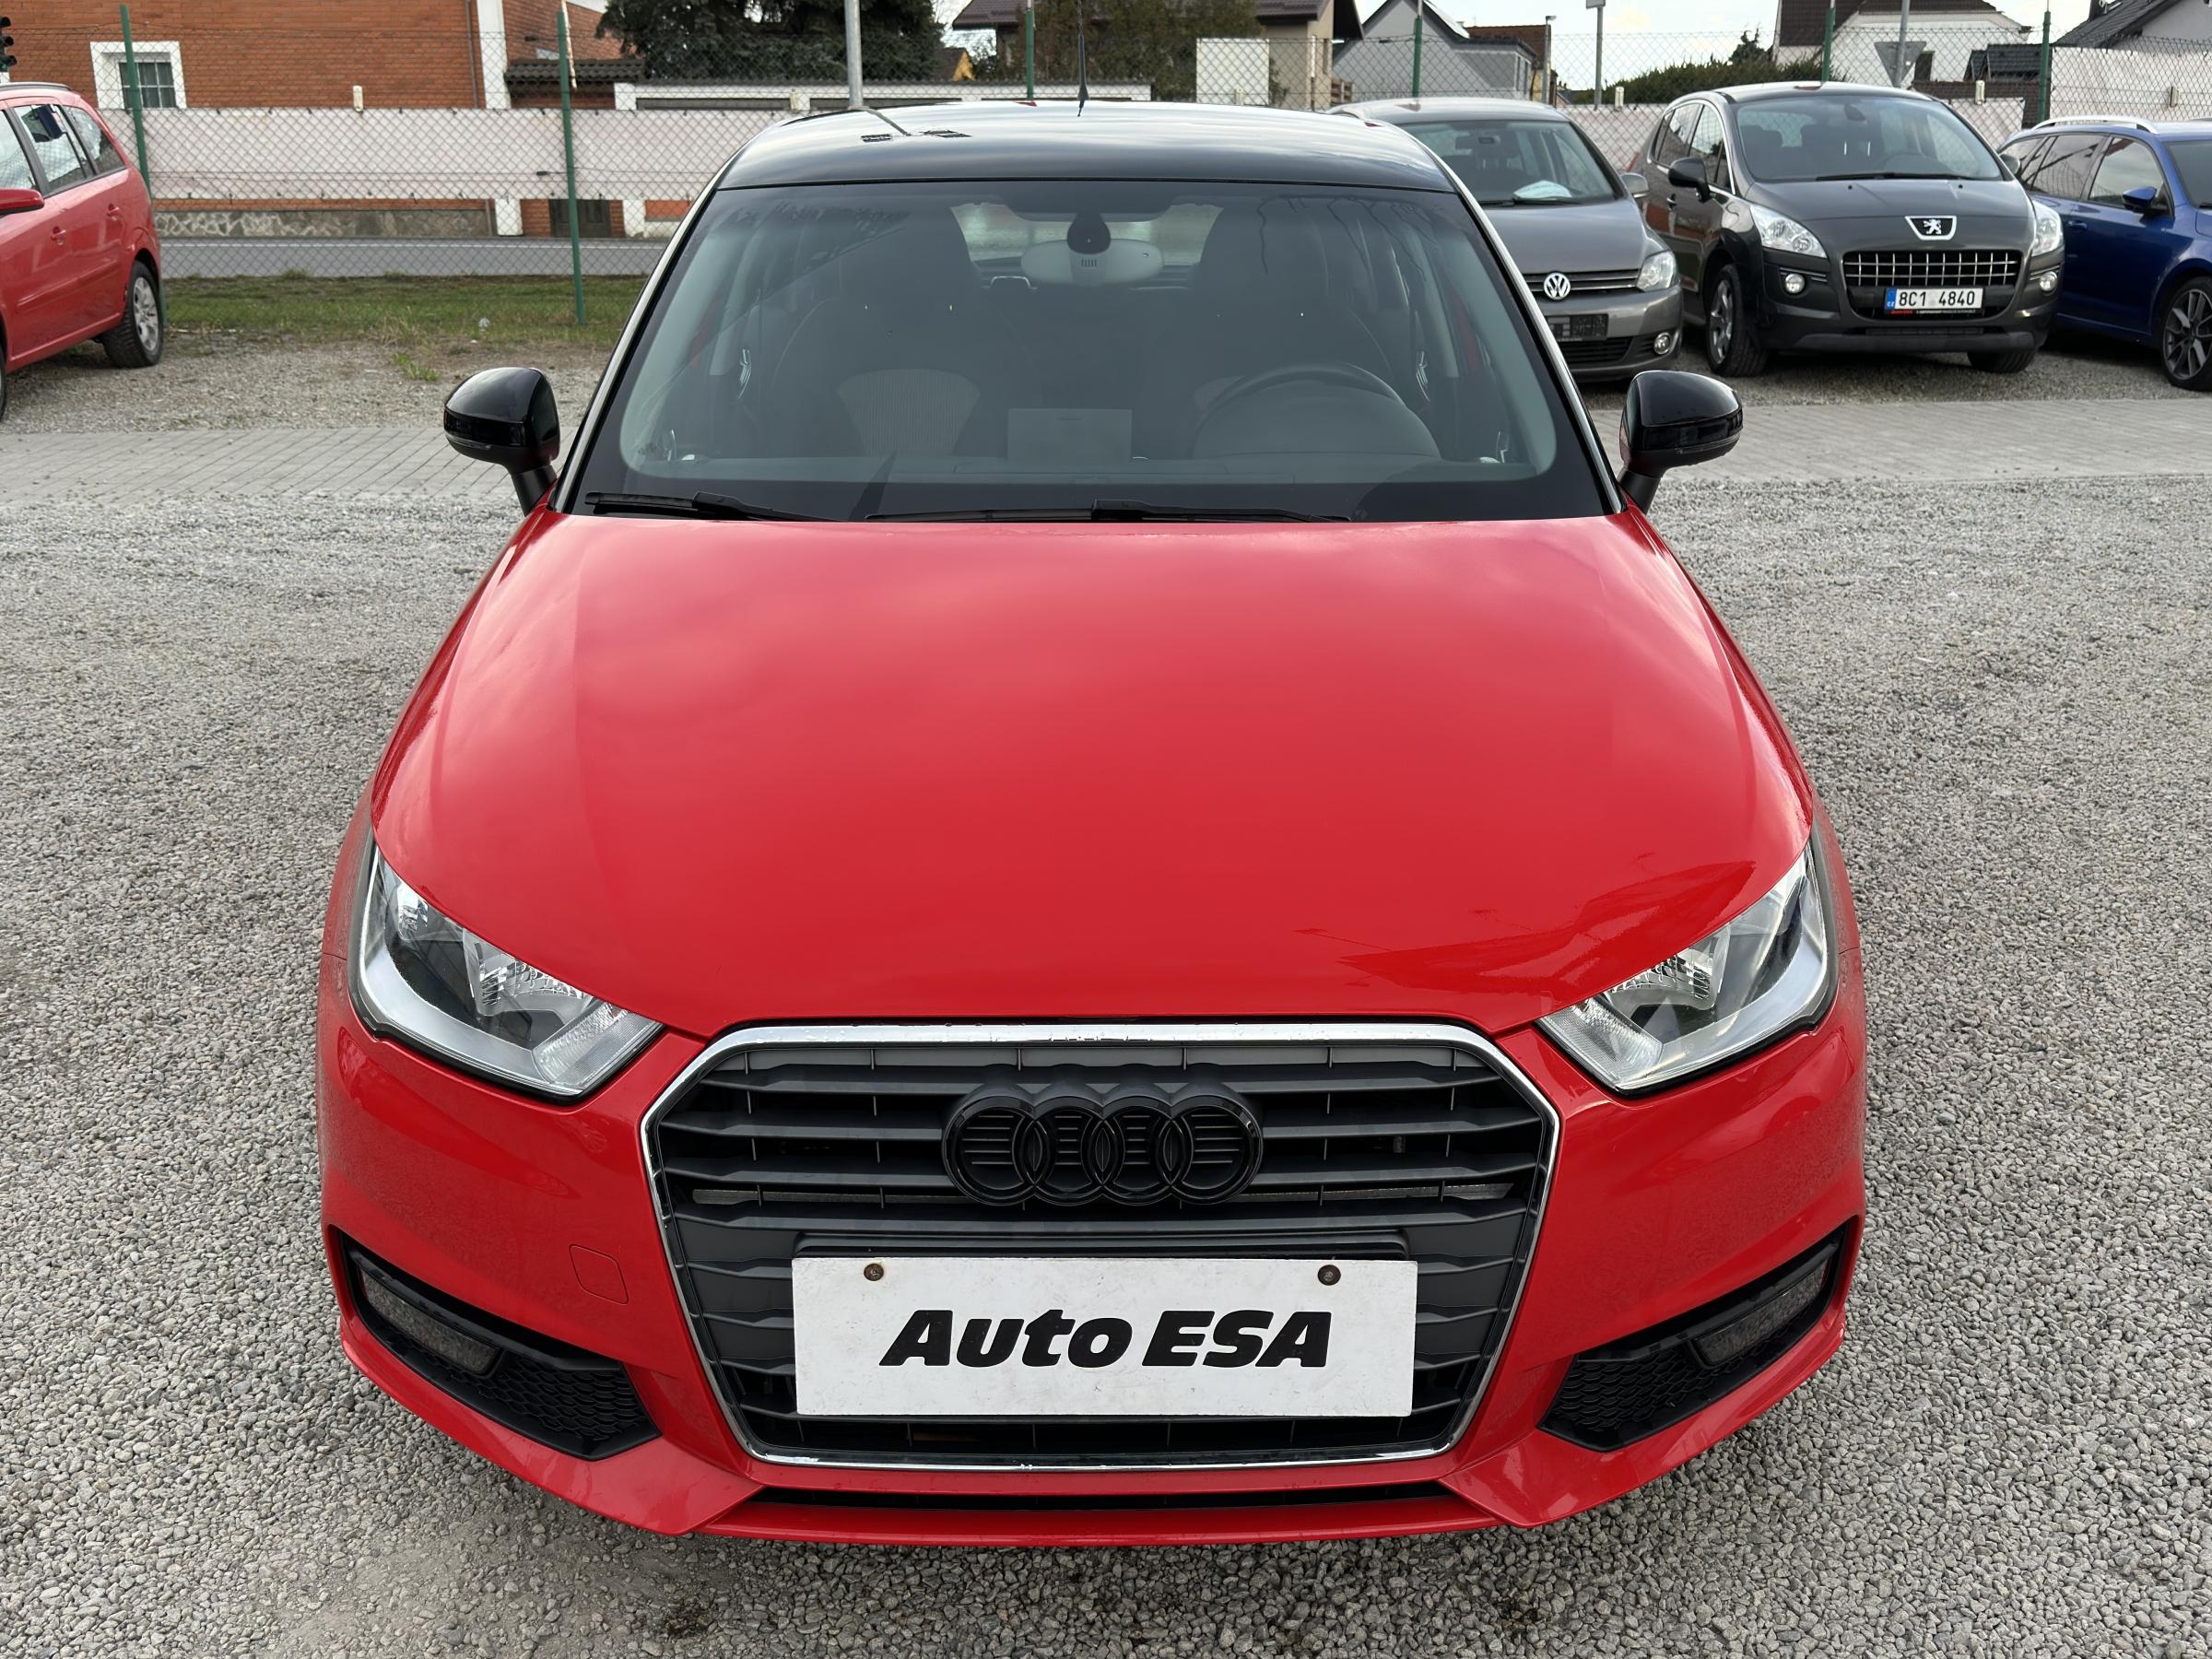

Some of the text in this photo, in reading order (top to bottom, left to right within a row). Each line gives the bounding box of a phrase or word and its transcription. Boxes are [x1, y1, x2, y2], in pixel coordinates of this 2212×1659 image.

[1899, 290, 1975, 307] 8C1 4840
[879, 1309, 1333, 1368] Auto ESA
